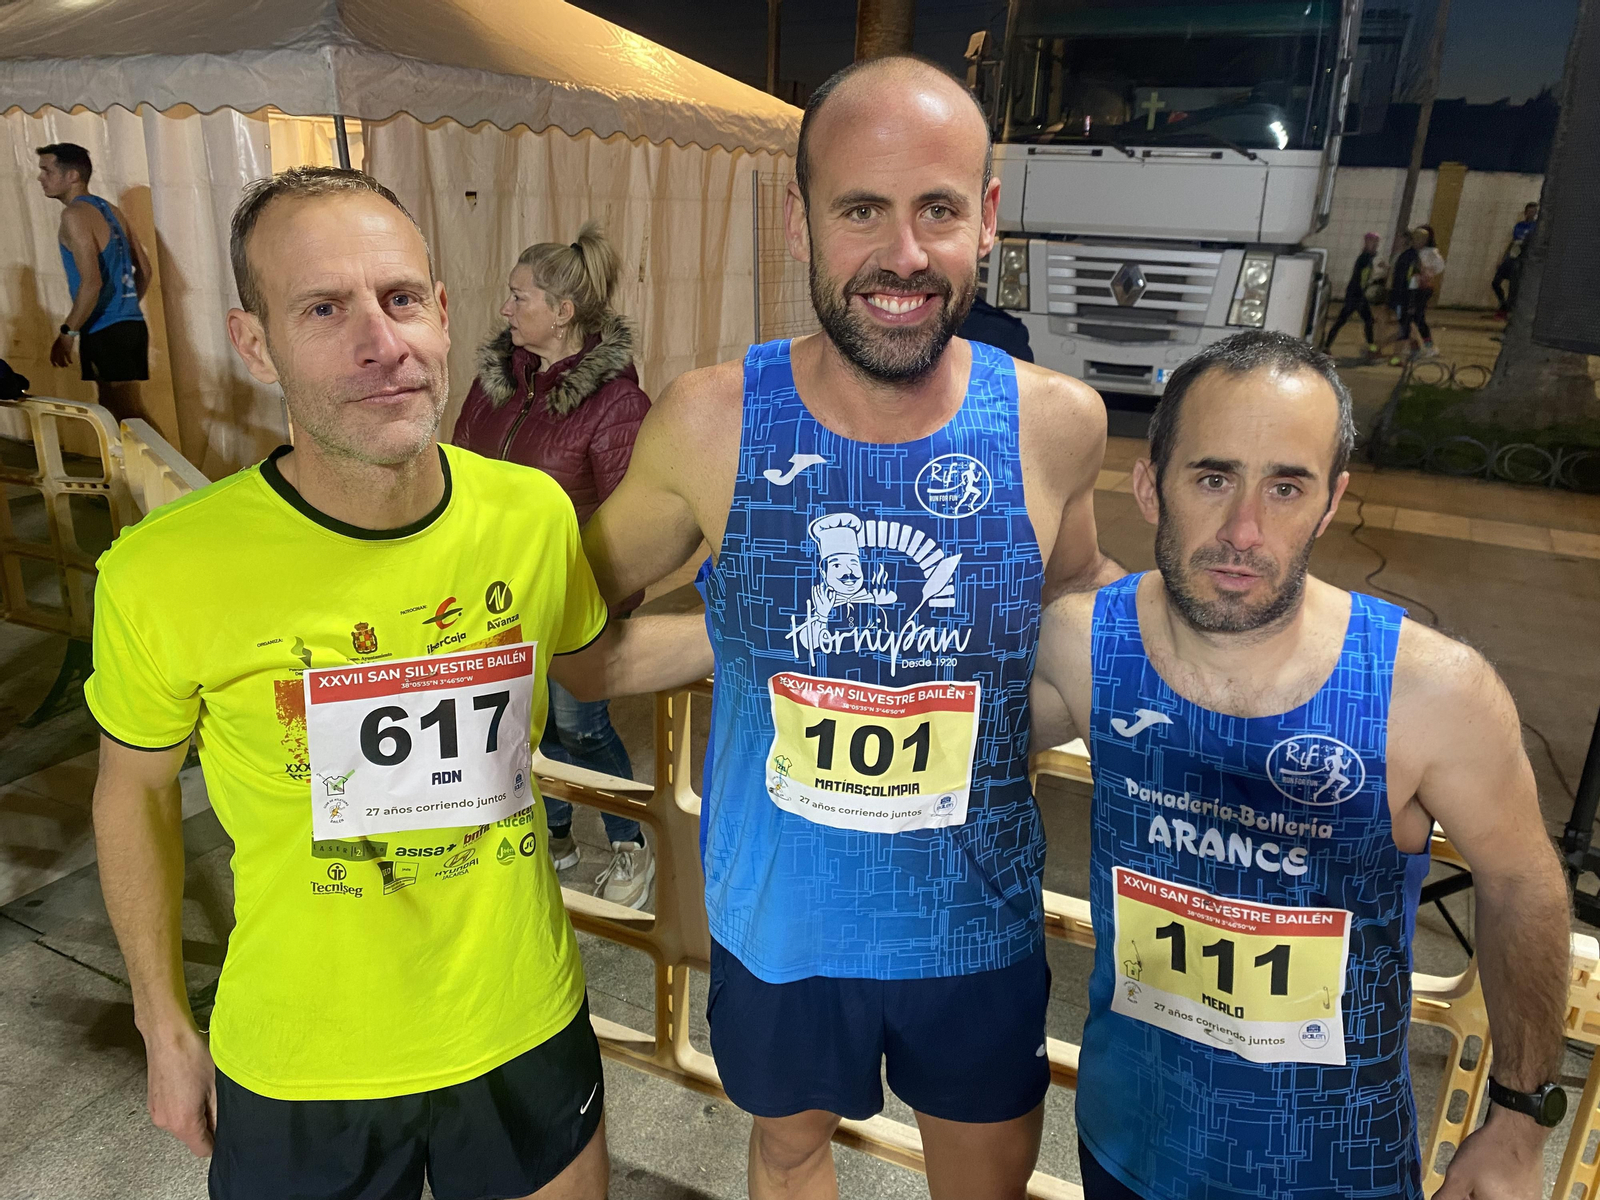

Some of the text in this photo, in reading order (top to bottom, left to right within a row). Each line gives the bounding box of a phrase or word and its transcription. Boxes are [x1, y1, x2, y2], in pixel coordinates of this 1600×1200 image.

[487, 613, 519, 631] Avanza
[785, 599, 971, 677] Hornipan
[318, 651, 526, 689] XXVII SAN SILVESTRE BAILÉN
[902, 657, 958, 669] Desde 1920
[816, 684, 845, 698] SAN
[847, 689, 916, 706] SILVESTRE
[359, 690, 511, 766] 617
[805, 718, 931, 777] 101
[431, 769, 462, 786] ADN
[366, 792, 507, 817] 27 años corriendo juntos
[800, 795, 922, 819] 27 años corriendo juntos
[1148, 814, 1309, 876] ARANCE
[435, 858, 479, 877] HYUNDAI
[310, 881, 363, 898] Tecniseg
[1123, 874, 1333, 925] XXVII SAN SILVESTRE BAILÉN
[1156, 921, 1292, 996] 111
[1202, 992, 1244, 1019] MERLO
[1153, 1002, 1286, 1046] 27 años corriendo juntos
